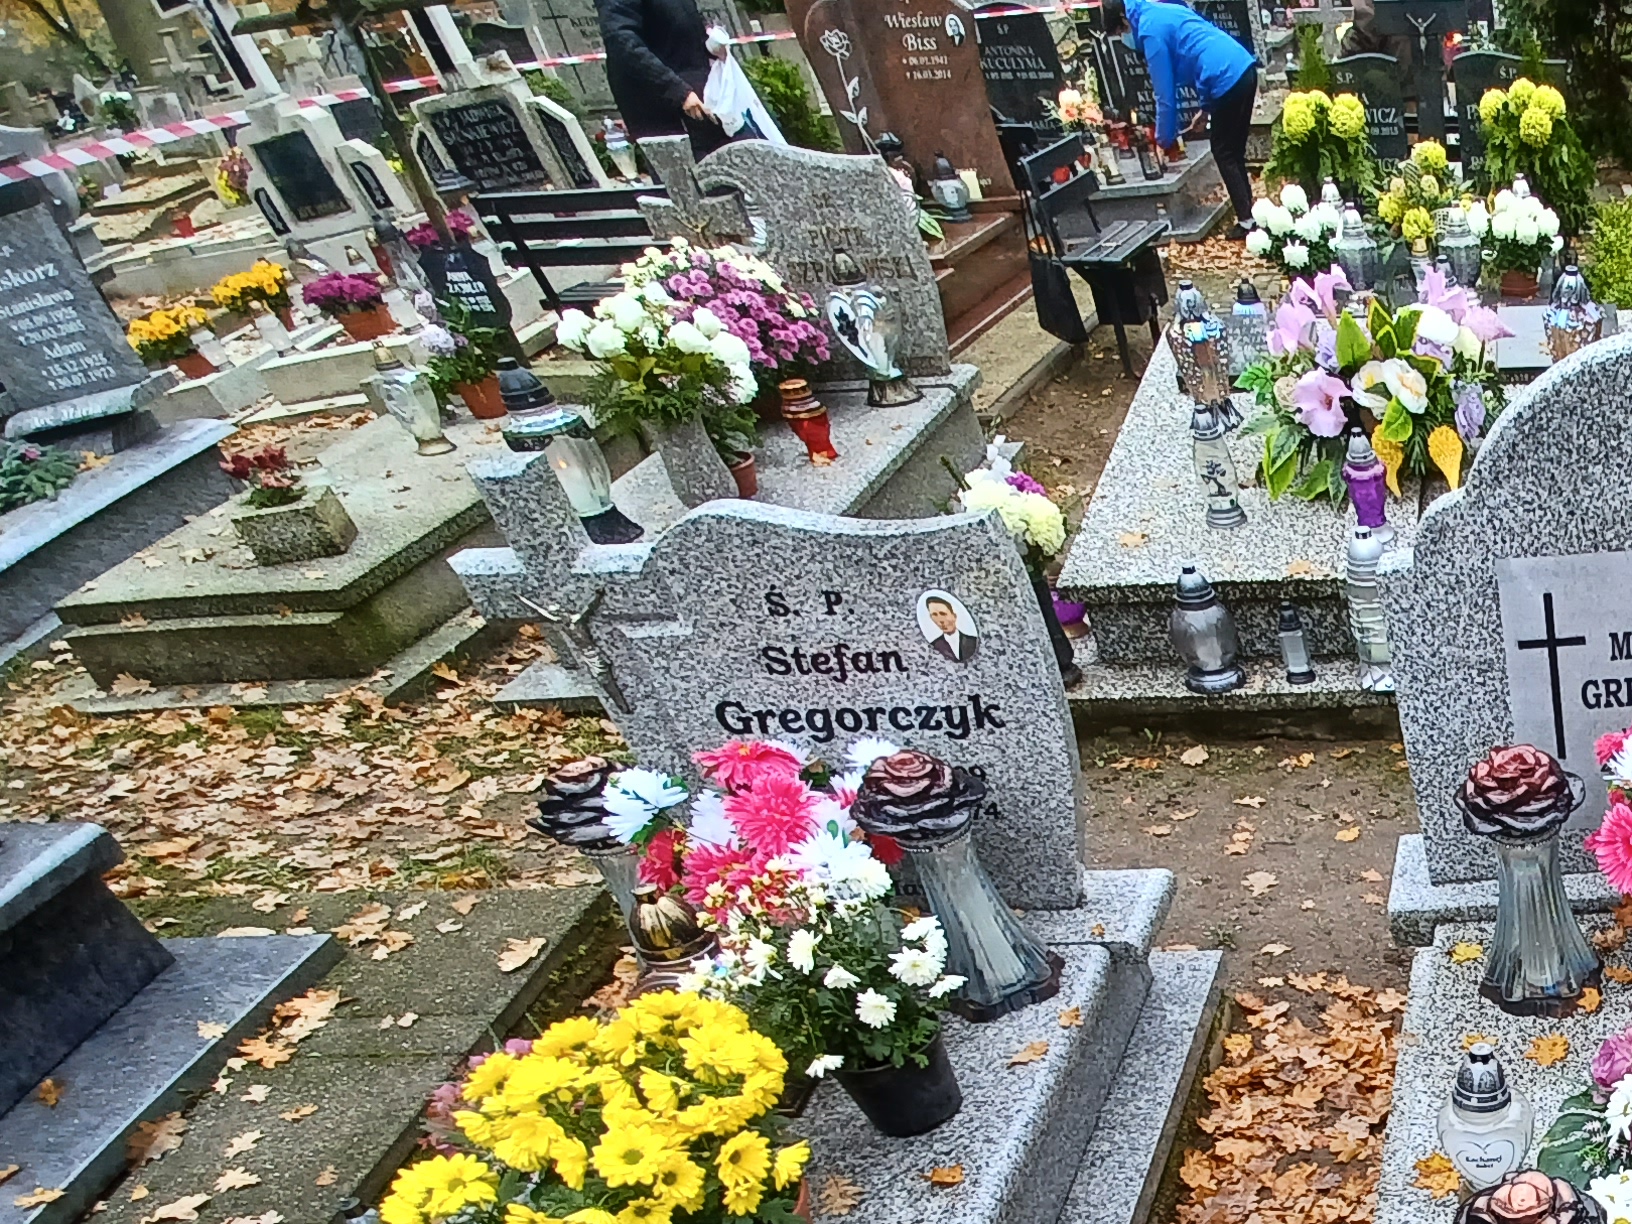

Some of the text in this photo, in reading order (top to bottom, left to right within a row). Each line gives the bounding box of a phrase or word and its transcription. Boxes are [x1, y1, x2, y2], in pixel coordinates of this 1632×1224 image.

[902, 33, 938, 52] Biss
[0, 262, 60, 292] skorz
[42, 341, 87, 360] Adam
[821, 590, 855, 615] P.
[762, 643, 909, 684] Stefan
[715, 694, 1007, 744] Gregorczyk
